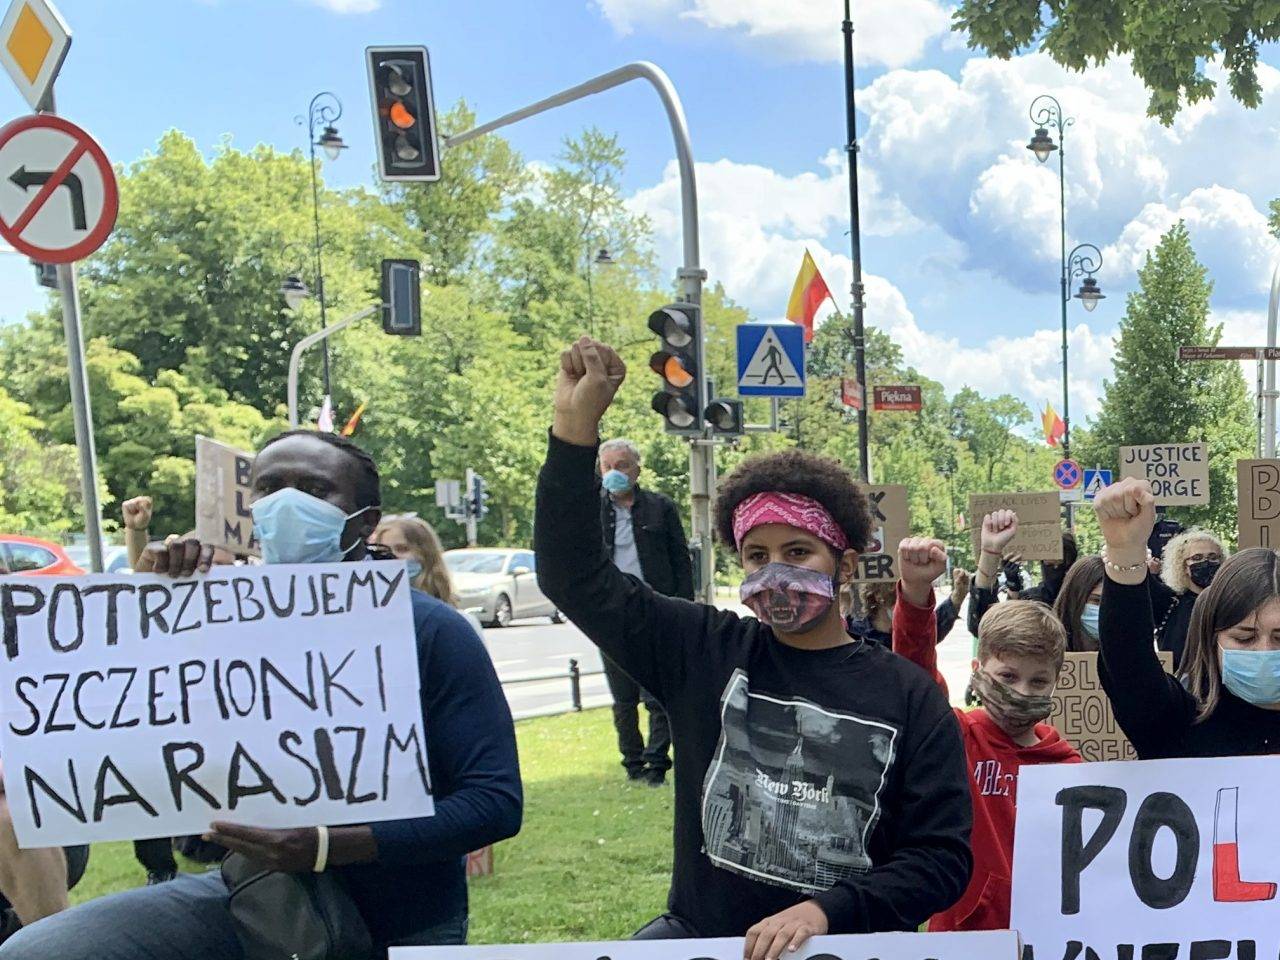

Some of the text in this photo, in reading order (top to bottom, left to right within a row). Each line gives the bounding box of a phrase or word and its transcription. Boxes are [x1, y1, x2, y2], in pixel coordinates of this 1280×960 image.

[1125, 446, 1202, 464] JUSTICE
[1146, 463, 1179, 478] FOR
[1149, 479, 1202, 497] ORGE
[1, 569, 405, 659] POTRZEBUJEMY
[9, 645, 388, 736] SZCZEPIONKI
[755, 768, 788, 795] New
